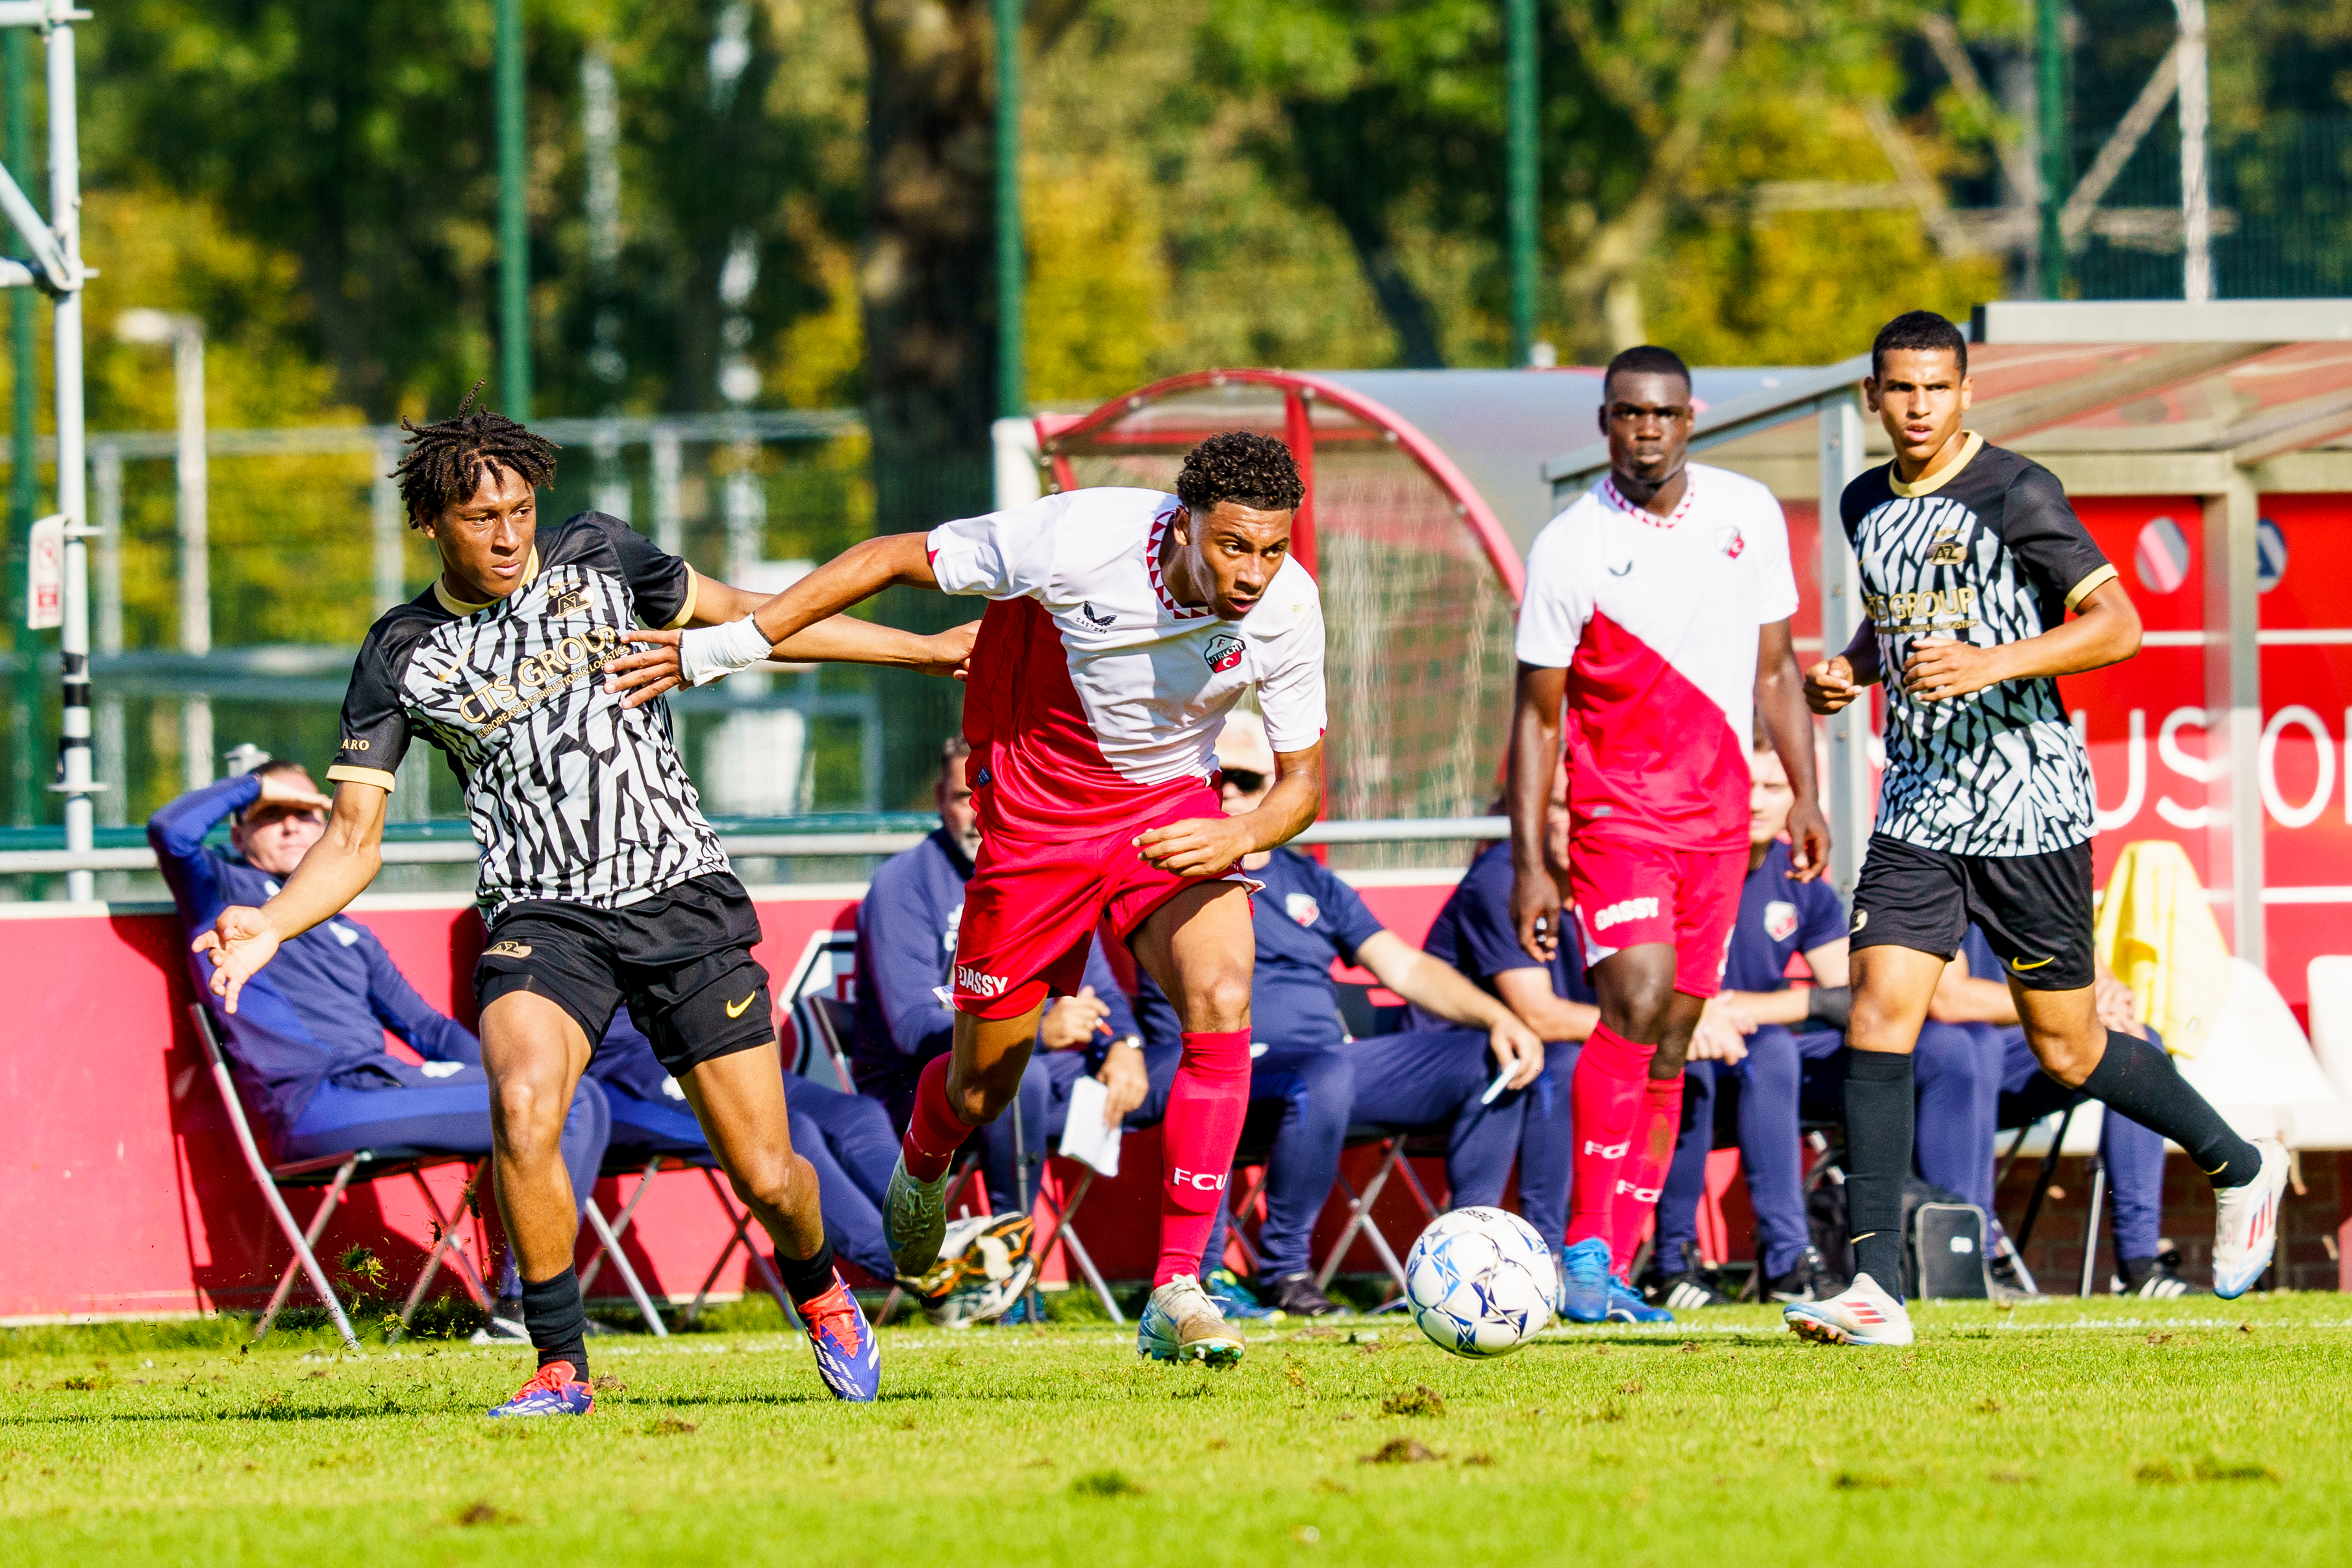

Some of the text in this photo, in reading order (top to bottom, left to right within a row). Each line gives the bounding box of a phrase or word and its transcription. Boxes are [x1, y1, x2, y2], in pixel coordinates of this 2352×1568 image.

[1933, 543, 1958, 562] AZ
[558, 591, 590, 616] AZ
[1888, 587, 1975, 620] GROUP
[1207, 642, 1244, 665] UTRECHT
[1216, 638, 1226, 648] F
[1222, 656, 1234, 667] C
[459, 626, 616, 724] CTS GROUP
[477, 645, 631, 740] EUROPEAN DISTRIBUTION & LOGISTICS
[339, 738, 369, 751] ARO
[1595, 897, 1659, 931] DASSY
[957, 965, 1008, 997] DASSY
